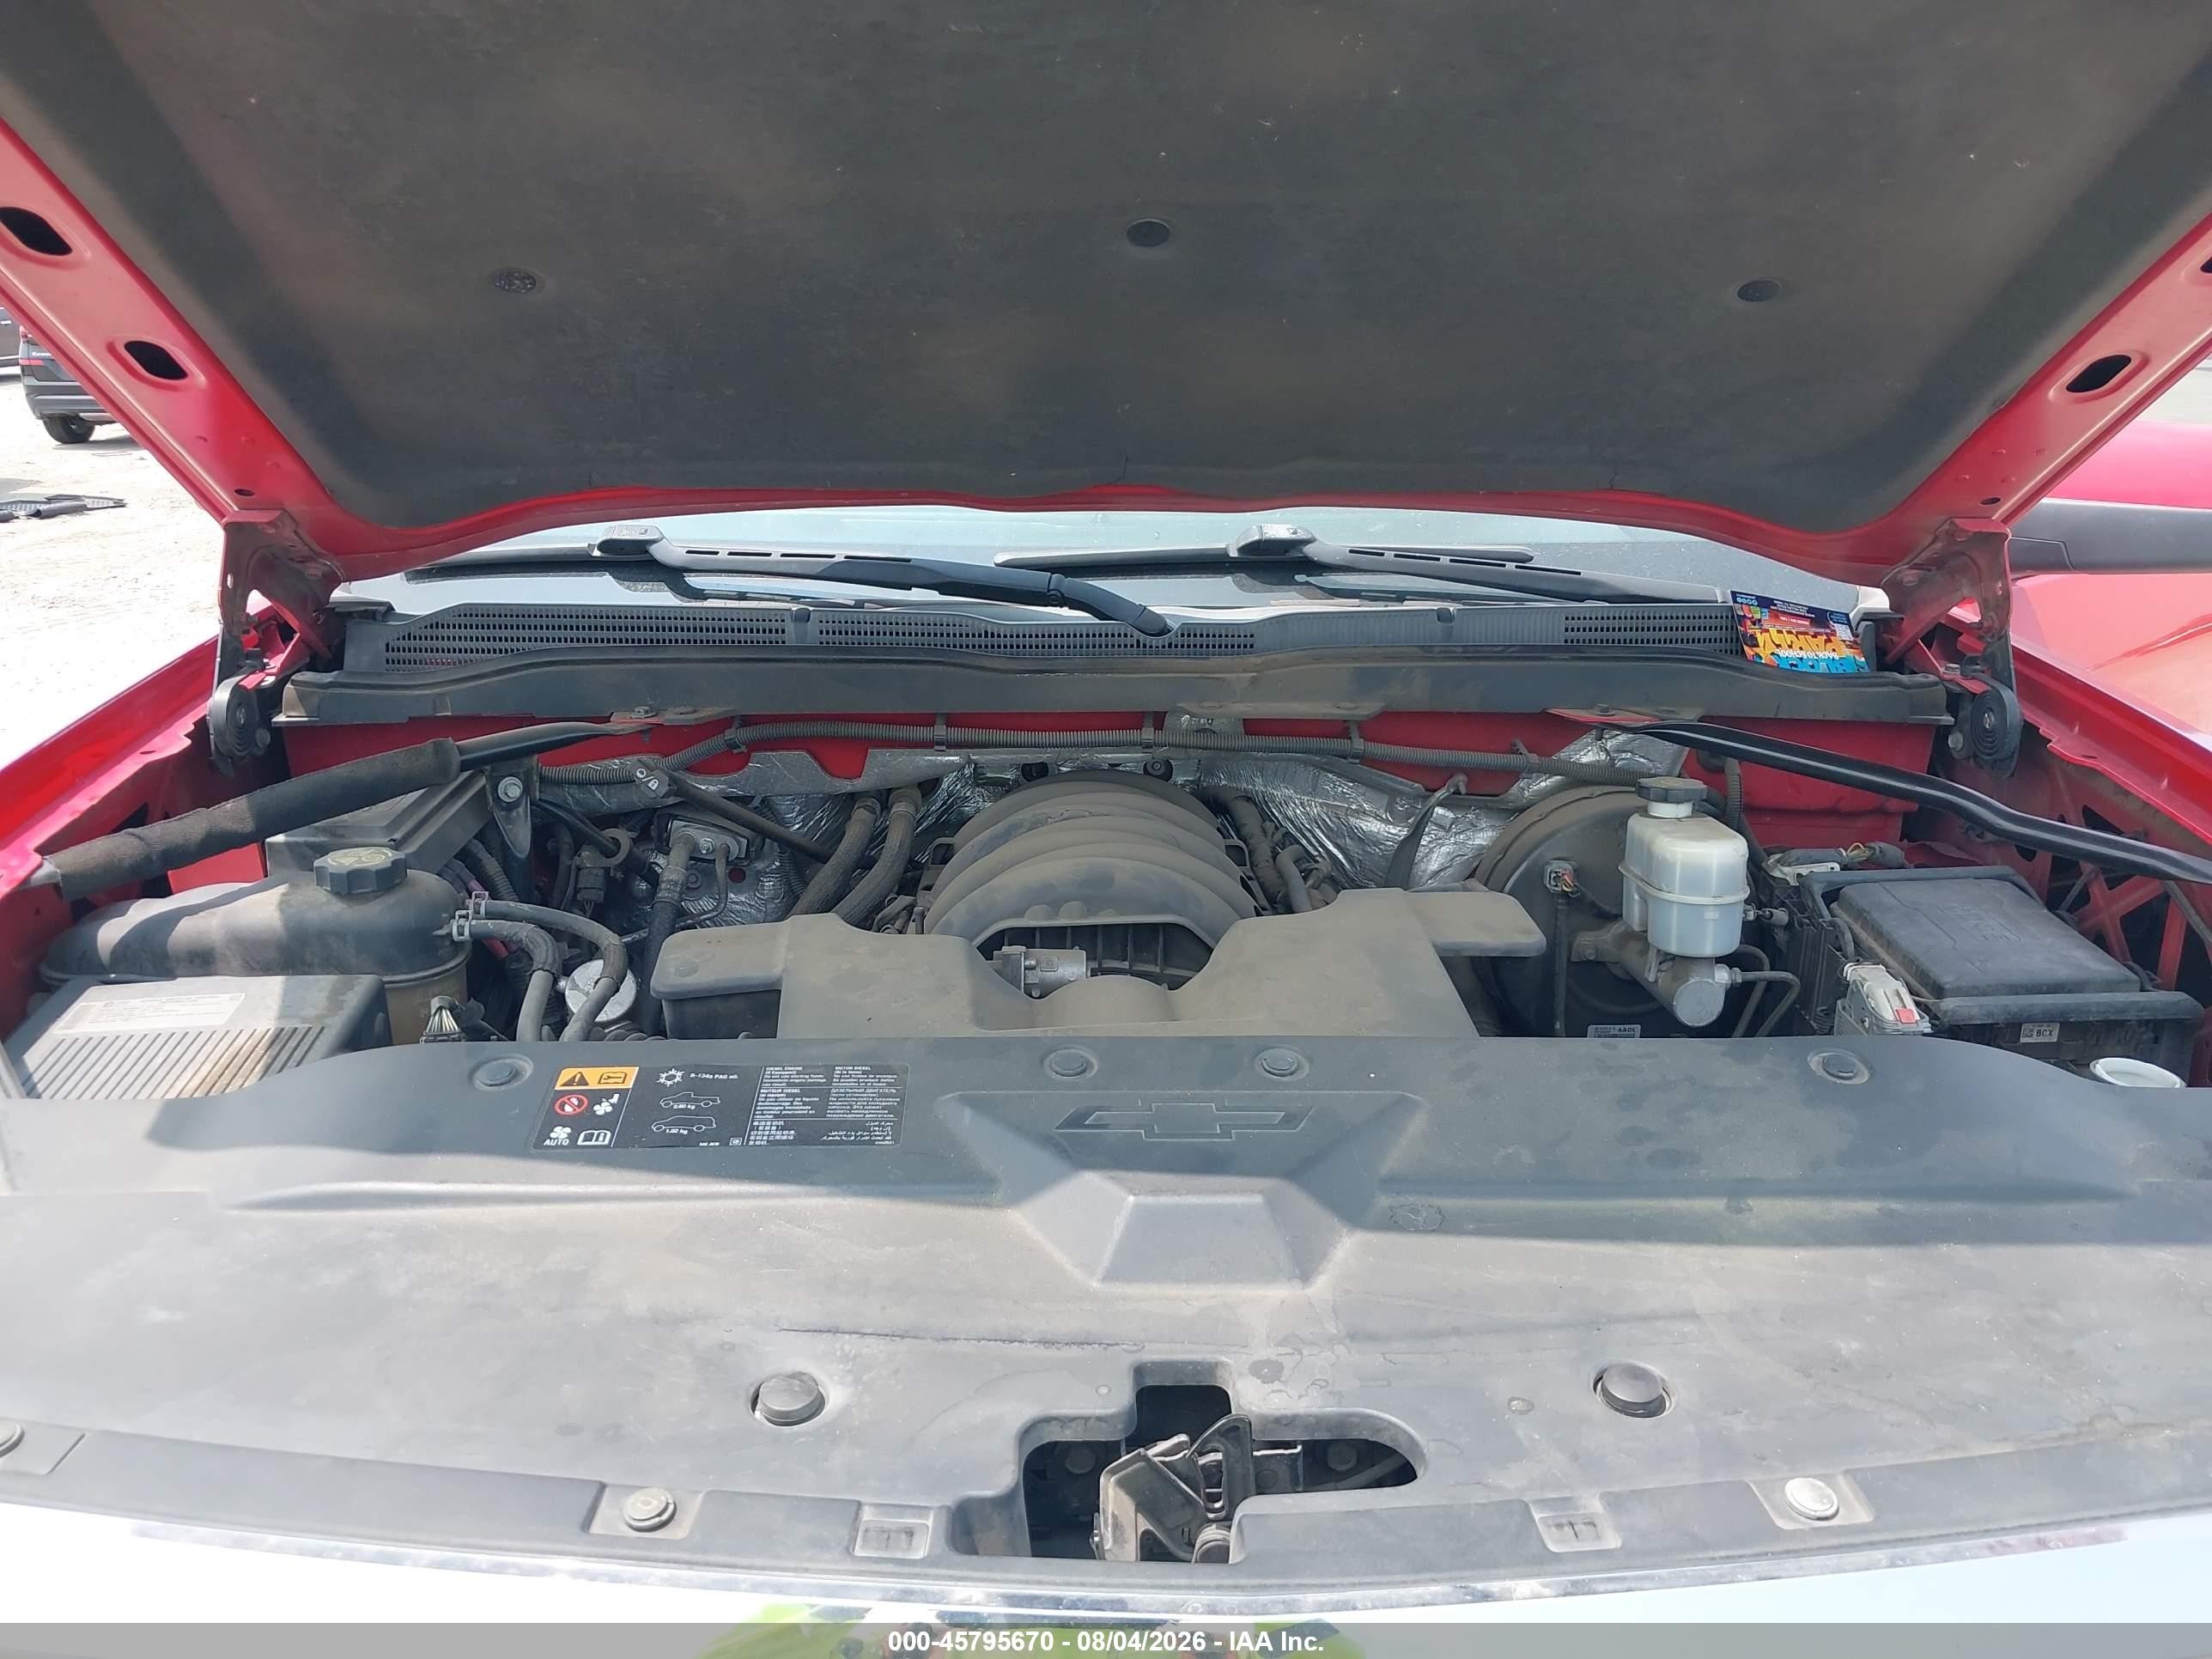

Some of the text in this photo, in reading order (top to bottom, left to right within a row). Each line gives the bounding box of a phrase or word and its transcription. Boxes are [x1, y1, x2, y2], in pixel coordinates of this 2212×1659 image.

[1756, 629, 1846, 656] PARTY
[1775, 649, 1839, 659] BACK TO SCHOOL
